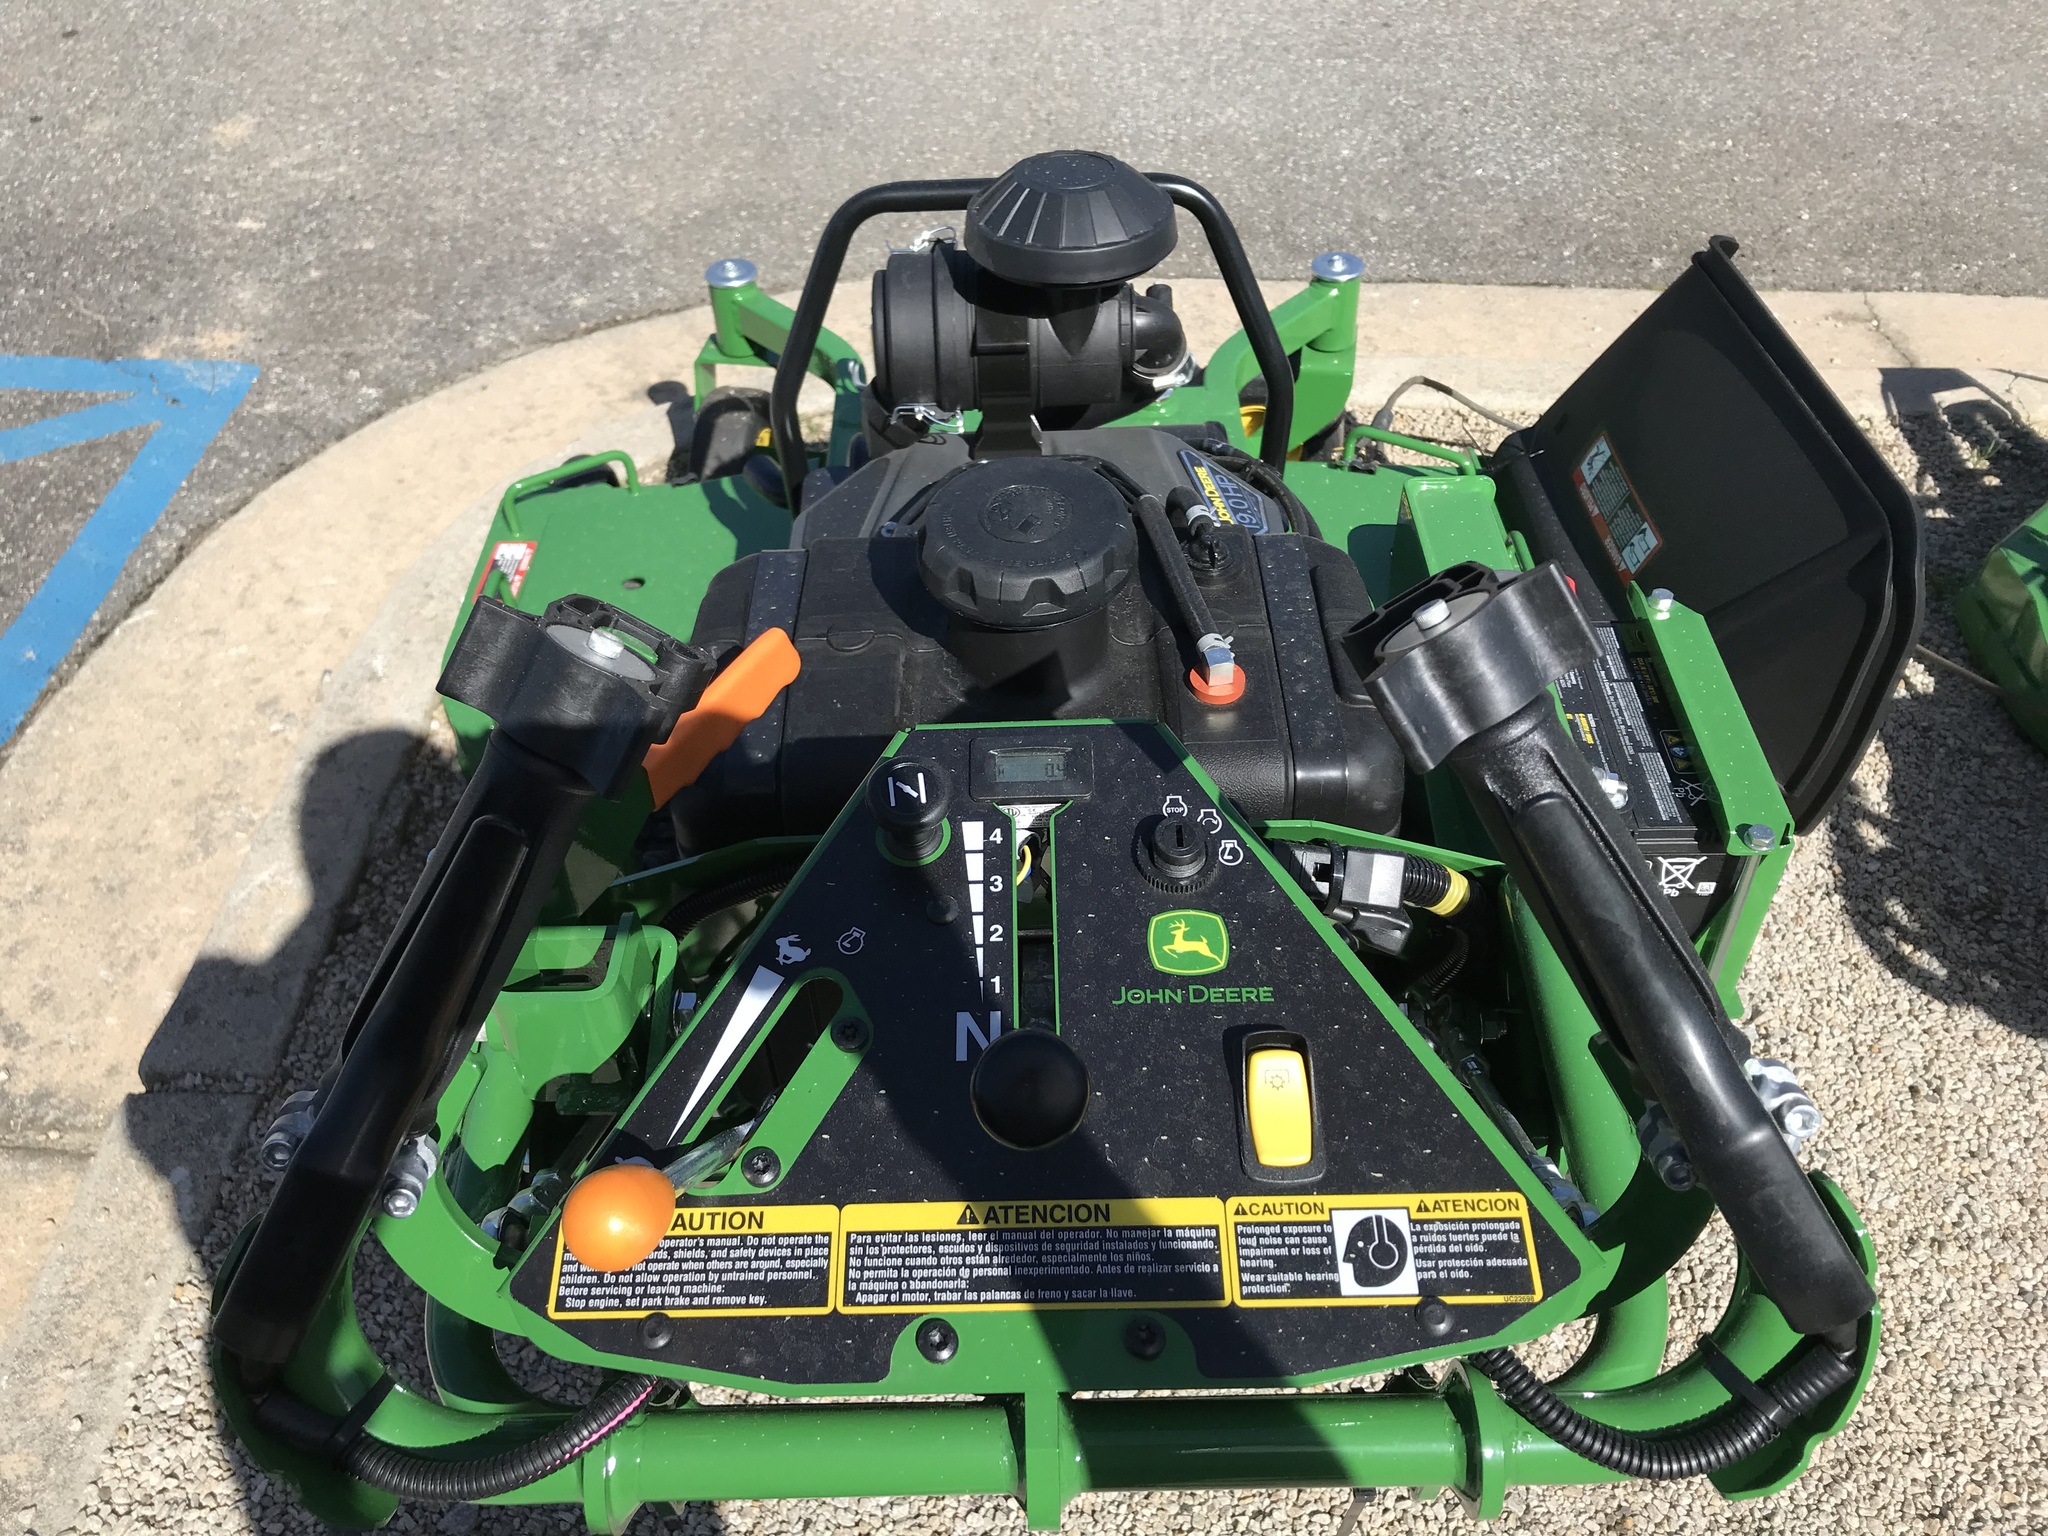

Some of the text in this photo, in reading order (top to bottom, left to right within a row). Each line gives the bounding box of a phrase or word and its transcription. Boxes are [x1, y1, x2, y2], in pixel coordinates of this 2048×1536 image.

[1214, 475, 1243, 497] HP
[1194, 466, 1234, 525] JOHN DEERE
[989, 829, 1003, 844] 4
[989, 876, 1004, 892] 3
[1663, 888, 1680, 897] Pb
[989, 924, 1004, 942] 2
[990, 975, 1001, 993] 1
[1112, 984, 1274, 1005] JOHN DEERE
[955, 1010, 1001, 1062] N
[1248, 1202, 1324, 1216] CAUTION
[1431, 1198, 1520, 1213] ATENCION
[671, 1211, 764, 1231] AUTION
[983, 1203, 1111, 1225] ATENCION
[1237, 1222, 1333, 1235] Prolonged exposure to
[1410, 1219, 1520, 1232] La exposición prolongada
[659, 1234, 828, 1248] operator's manual. Do not operate the
[850, 1227, 1216, 1243] Para evitar las lesiones, leer el manual del operador. No manejar la máquina
[1238, 1235, 1327, 1245] loud noise can cause
[1419, 1232, 1446, 1241] ruidos
[1448, 1231, 1479, 1241] fuertes
[1481, 1231, 1508, 1241] puede
[1510, 1231, 1519, 1239] la
[646, 1246, 828, 1260] ards, shields, and safety devices in place
[849, 1239, 1217, 1255] sin los protectores, escudos y dispositivos de seguridad instalados y funcionando.
[1239, 1245, 1288, 1258] impairment
[1302, 1245, 1320, 1254] loss
[1322, 1244, 1331, 1254] of
[1413, 1242, 1487, 1254] pérdida del oído.
[562, 1261, 578, 1271] and
[647, 1259, 679, 1272] operate
[681, 1259, 704, 1269] when
[706, 1259, 732, 1269] others
[735, 1260, 748, 1268] are
[750, 1258, 782, 1270] around,
[785, 1257, 828, 1269] especially
[849, 1251, 1153, 1266] No funcione cuando otros están alrededor, especialmente los niños.
[1240, 1257, 1276, 1269] hearing.
[1415, 1256, 1527, 1268] Usar protección adecuada
[560, 1269, 814, 1283] children. Do not allow operation by untrained personnel.
[849, 1262, 1218, 1279] No permita la operación de personal inexperimentado. Antes de realizar servicio a
[1241, 1269, 1340, 1282] Wear suitable hearing
[1417, 1268, 1472, 1280] para el oído.
[559, 1282, 725, 1296] Before servicing or leaving machine:
[848, 1278, 968, 1292] la máquina o abandonarla:
[1242, 1283, 1290, 1295] protection.
[565, 1293, 767, 1308] Stop engine, set park brake and remove key.
[855, 1287, 1135, 1304] Apagar el motor, trabar las palancas de freno y sacar la llave.
